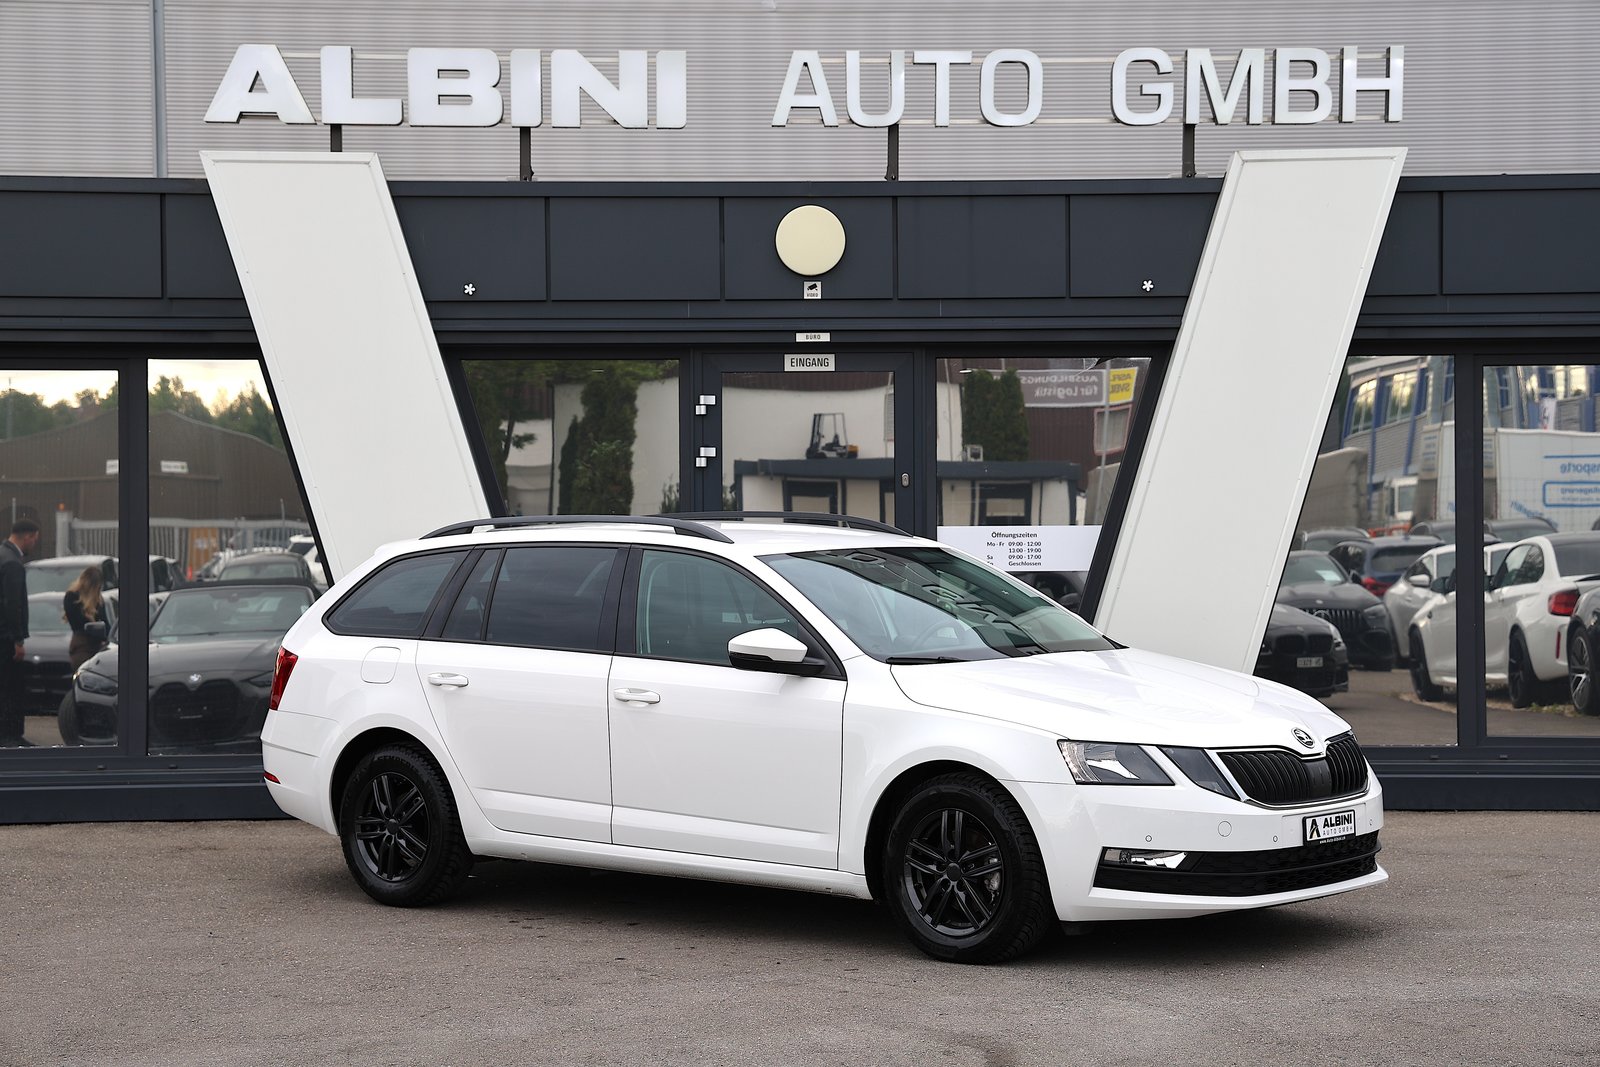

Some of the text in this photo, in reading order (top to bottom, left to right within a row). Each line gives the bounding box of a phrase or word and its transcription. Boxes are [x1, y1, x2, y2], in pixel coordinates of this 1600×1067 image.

[204, 43, 1404, 129] ALBINI AUTO GMBH
[790, 357, 829, 367] EINGANG
[1323, 814, 1352, 828] ALBINI
[1323, 828, 1337, 836] AUTO
